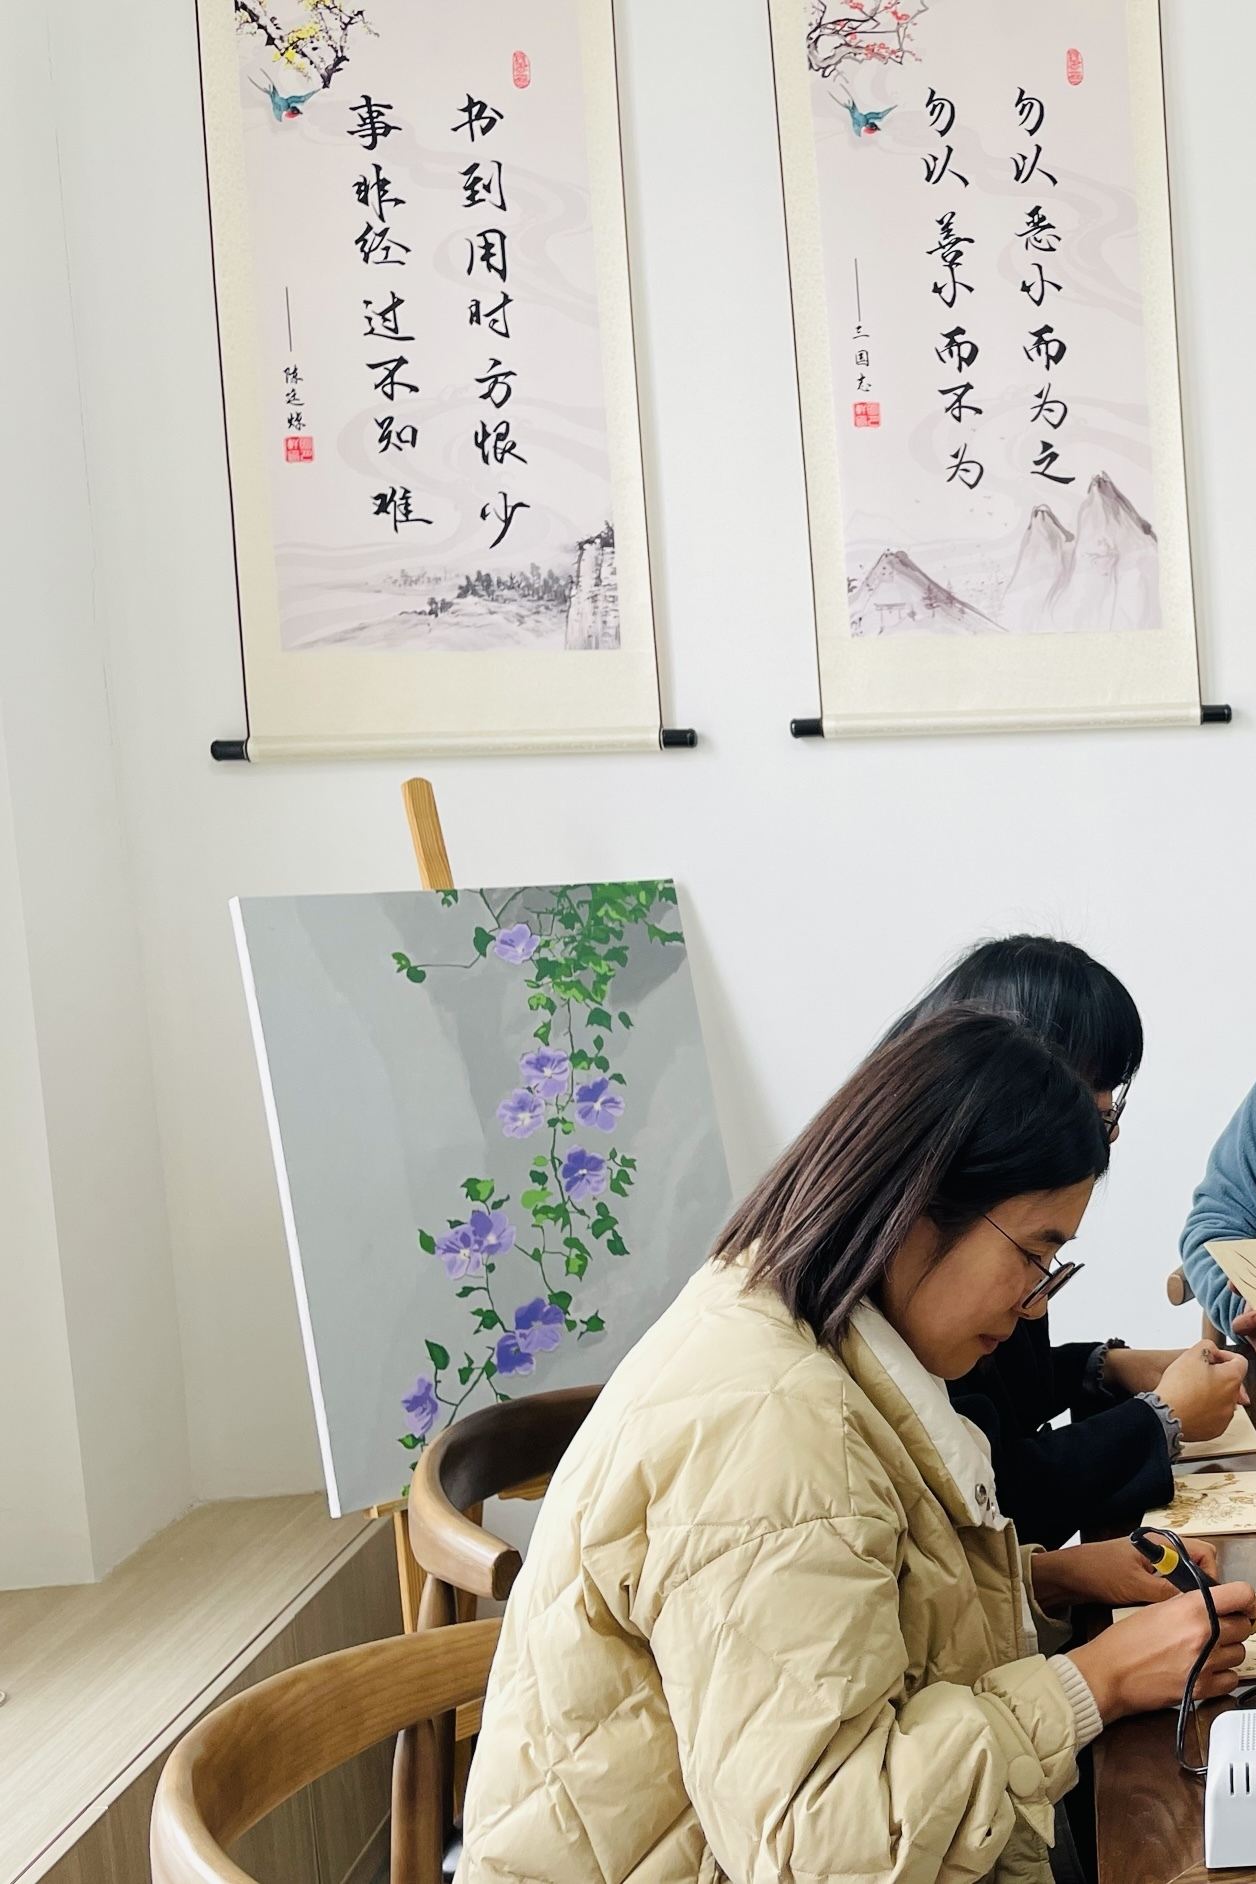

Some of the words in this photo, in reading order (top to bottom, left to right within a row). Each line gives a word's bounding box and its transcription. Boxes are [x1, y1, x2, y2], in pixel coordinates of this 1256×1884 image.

[346, 94, 434, 533] 事非经过不知难
[450, 93, 531, 549] 书到用时方恨少
[921, 87, 984, 490] 勿以善小而不为
[1010, 84, 1077, 486] 勿以恶小而为之
